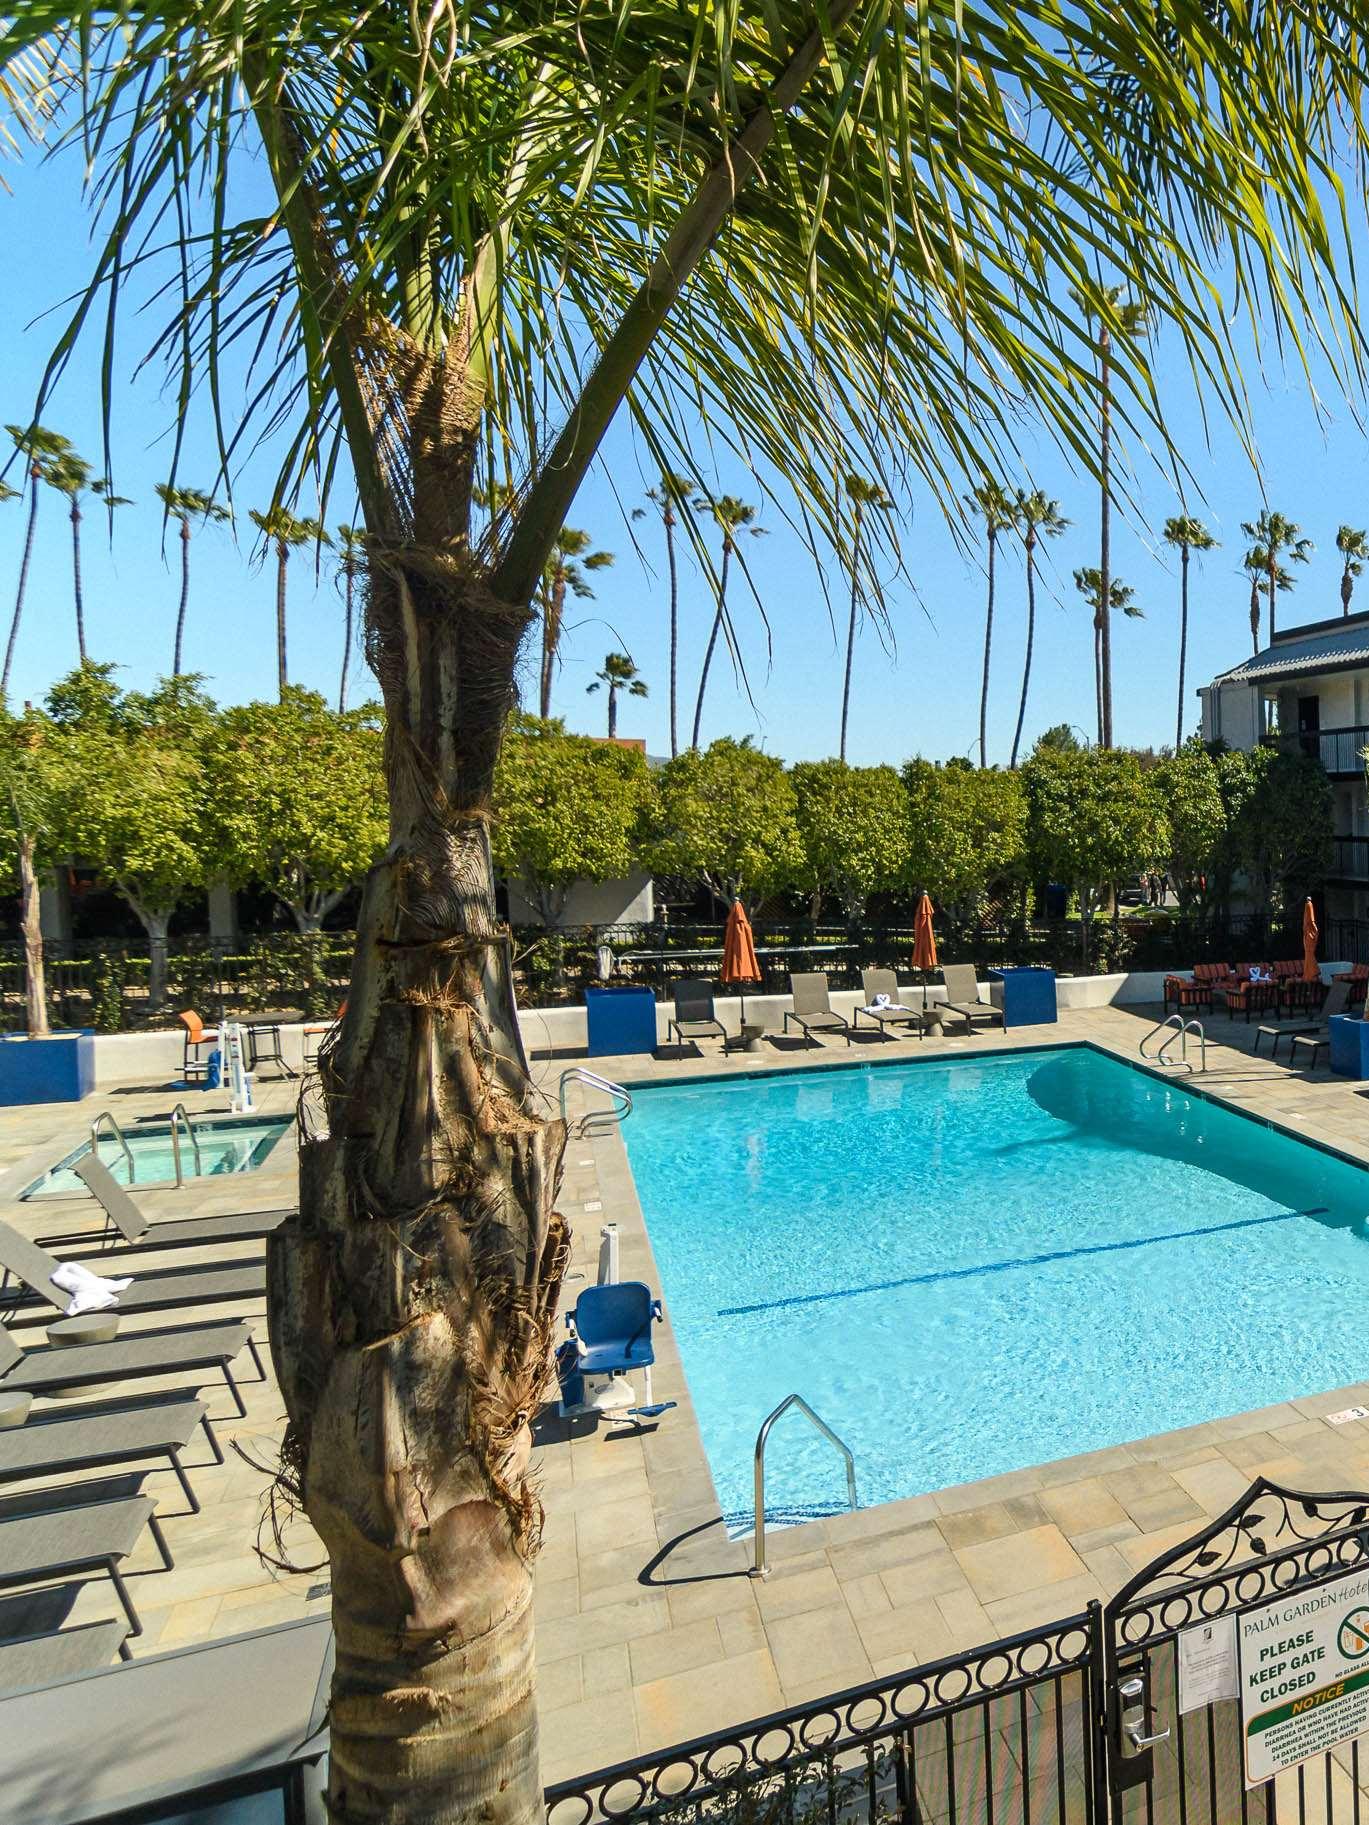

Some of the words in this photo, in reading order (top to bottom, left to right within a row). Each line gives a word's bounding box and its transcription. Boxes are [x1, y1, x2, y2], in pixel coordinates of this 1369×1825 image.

[1352, 1409, 1364, 1417] 3
[1244, 1613, 1279, 1638] PALM
[1283, 1592, 1337, 1622] GARDEN
[1338, 1582, 1369, 1600] Hote
[1260, 1630, 1314, 1662] PLEASE
[1249, 1661, 1287, 1688] KEEP
[1290, 1646, 1326, 1670] GATE
[1335, 1671, 1343, 1679] NO
[1344, 1664, 1360, 1675] GLASS
[1260, 1671, 1316, 1703] CLOSED
[1291, 1682, 1345, 1715] NOTICE
[1264, 1722, 1294, 1739] PERSONS
[1294, 1712, 1318, 1726] HAVING
[1318, 1698, 1352, 1715] CURRENTLY
[1264, 1730, 1296, 1747] DIARRHEA
[1307, 1719, 1322, 1728] WHO
[1323, 1711, 1339, 1721] HAVE
[1339, 1705, 1351, 1714] HAD
[1271, 1736, 1303, 1753] DIARRHEA
[1303, 1726, 1325, 1738] WITHIN
[1326, 1720, 1337, 1729] THE
[1338, 1707, 1367, 1724] PREVIOUS
[1272, 1754, 1280, 1762] 14
[1281, 1747, 1295, 1758] DAYS
[1298, 1738, 1316, 1750] SHALL
[1317, 1733, 1330, 1742] NOT
[1339, 1715, 1367, 1731] ALLOWED
[1290, 1750, 1309, 1762] ENTER
[1310, 1744, 1321, 1752] THE
[1322, 1736, 1338, 1748] POOL
[1339, 1727, 1359, 1740] WATER
